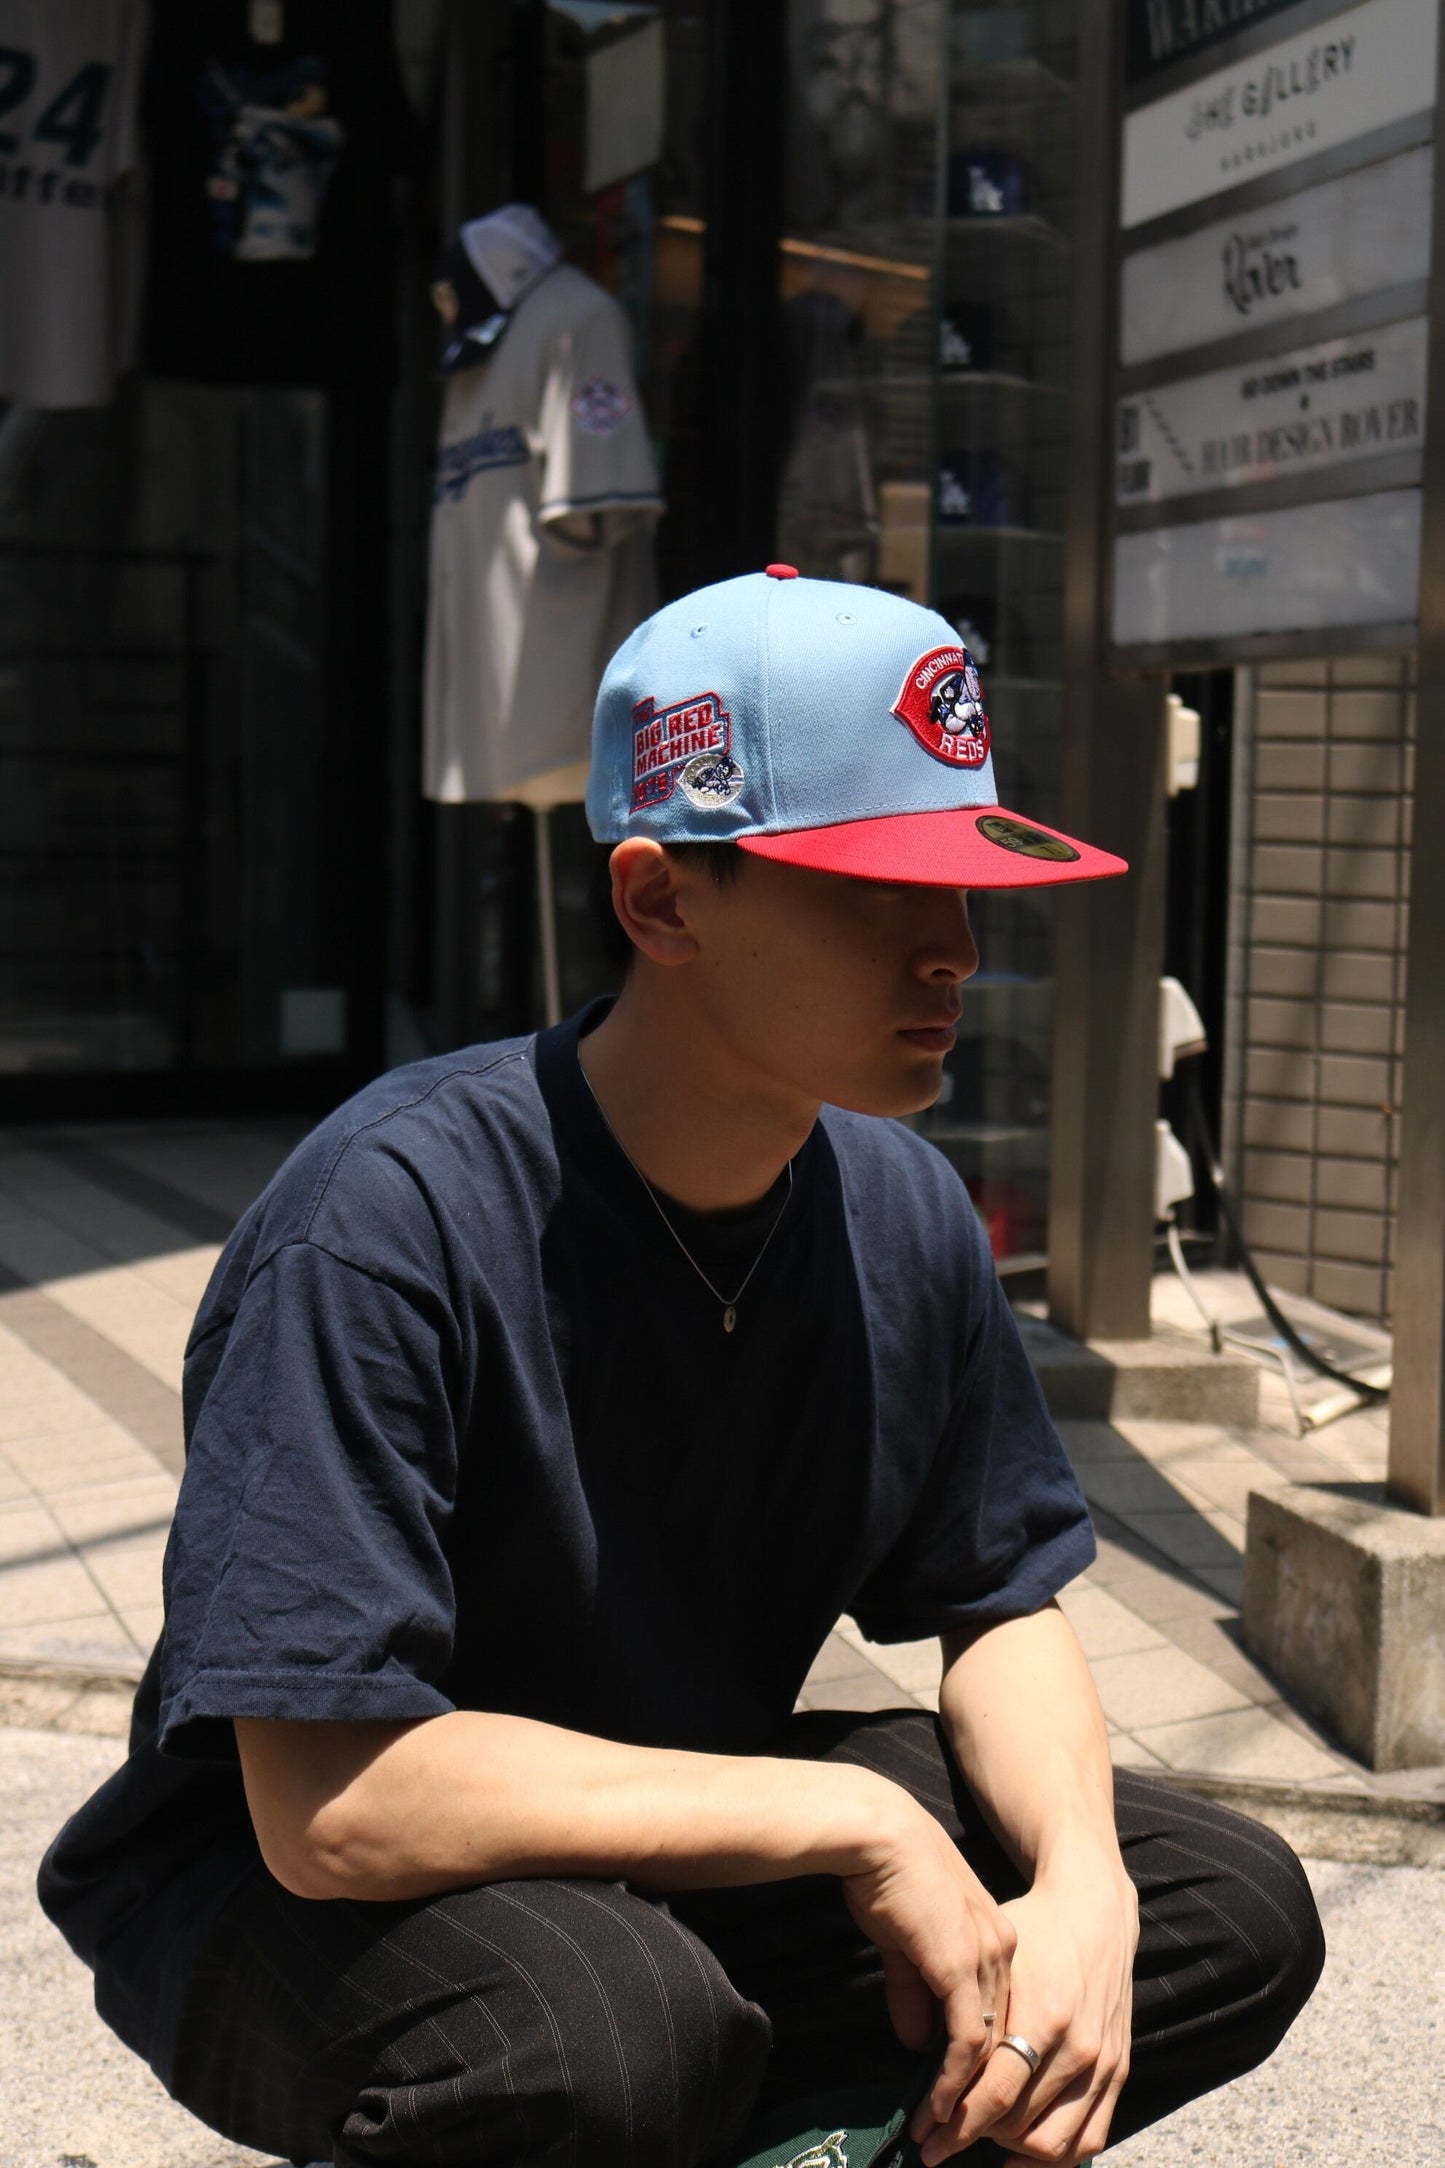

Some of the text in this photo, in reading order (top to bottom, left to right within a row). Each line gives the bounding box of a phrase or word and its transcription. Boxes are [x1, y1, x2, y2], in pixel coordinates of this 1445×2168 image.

[636, 703, 713, 757] BIG RED
[636, 723, 722, 777] MACHINE
[938, 733, 984, 761] REDS
